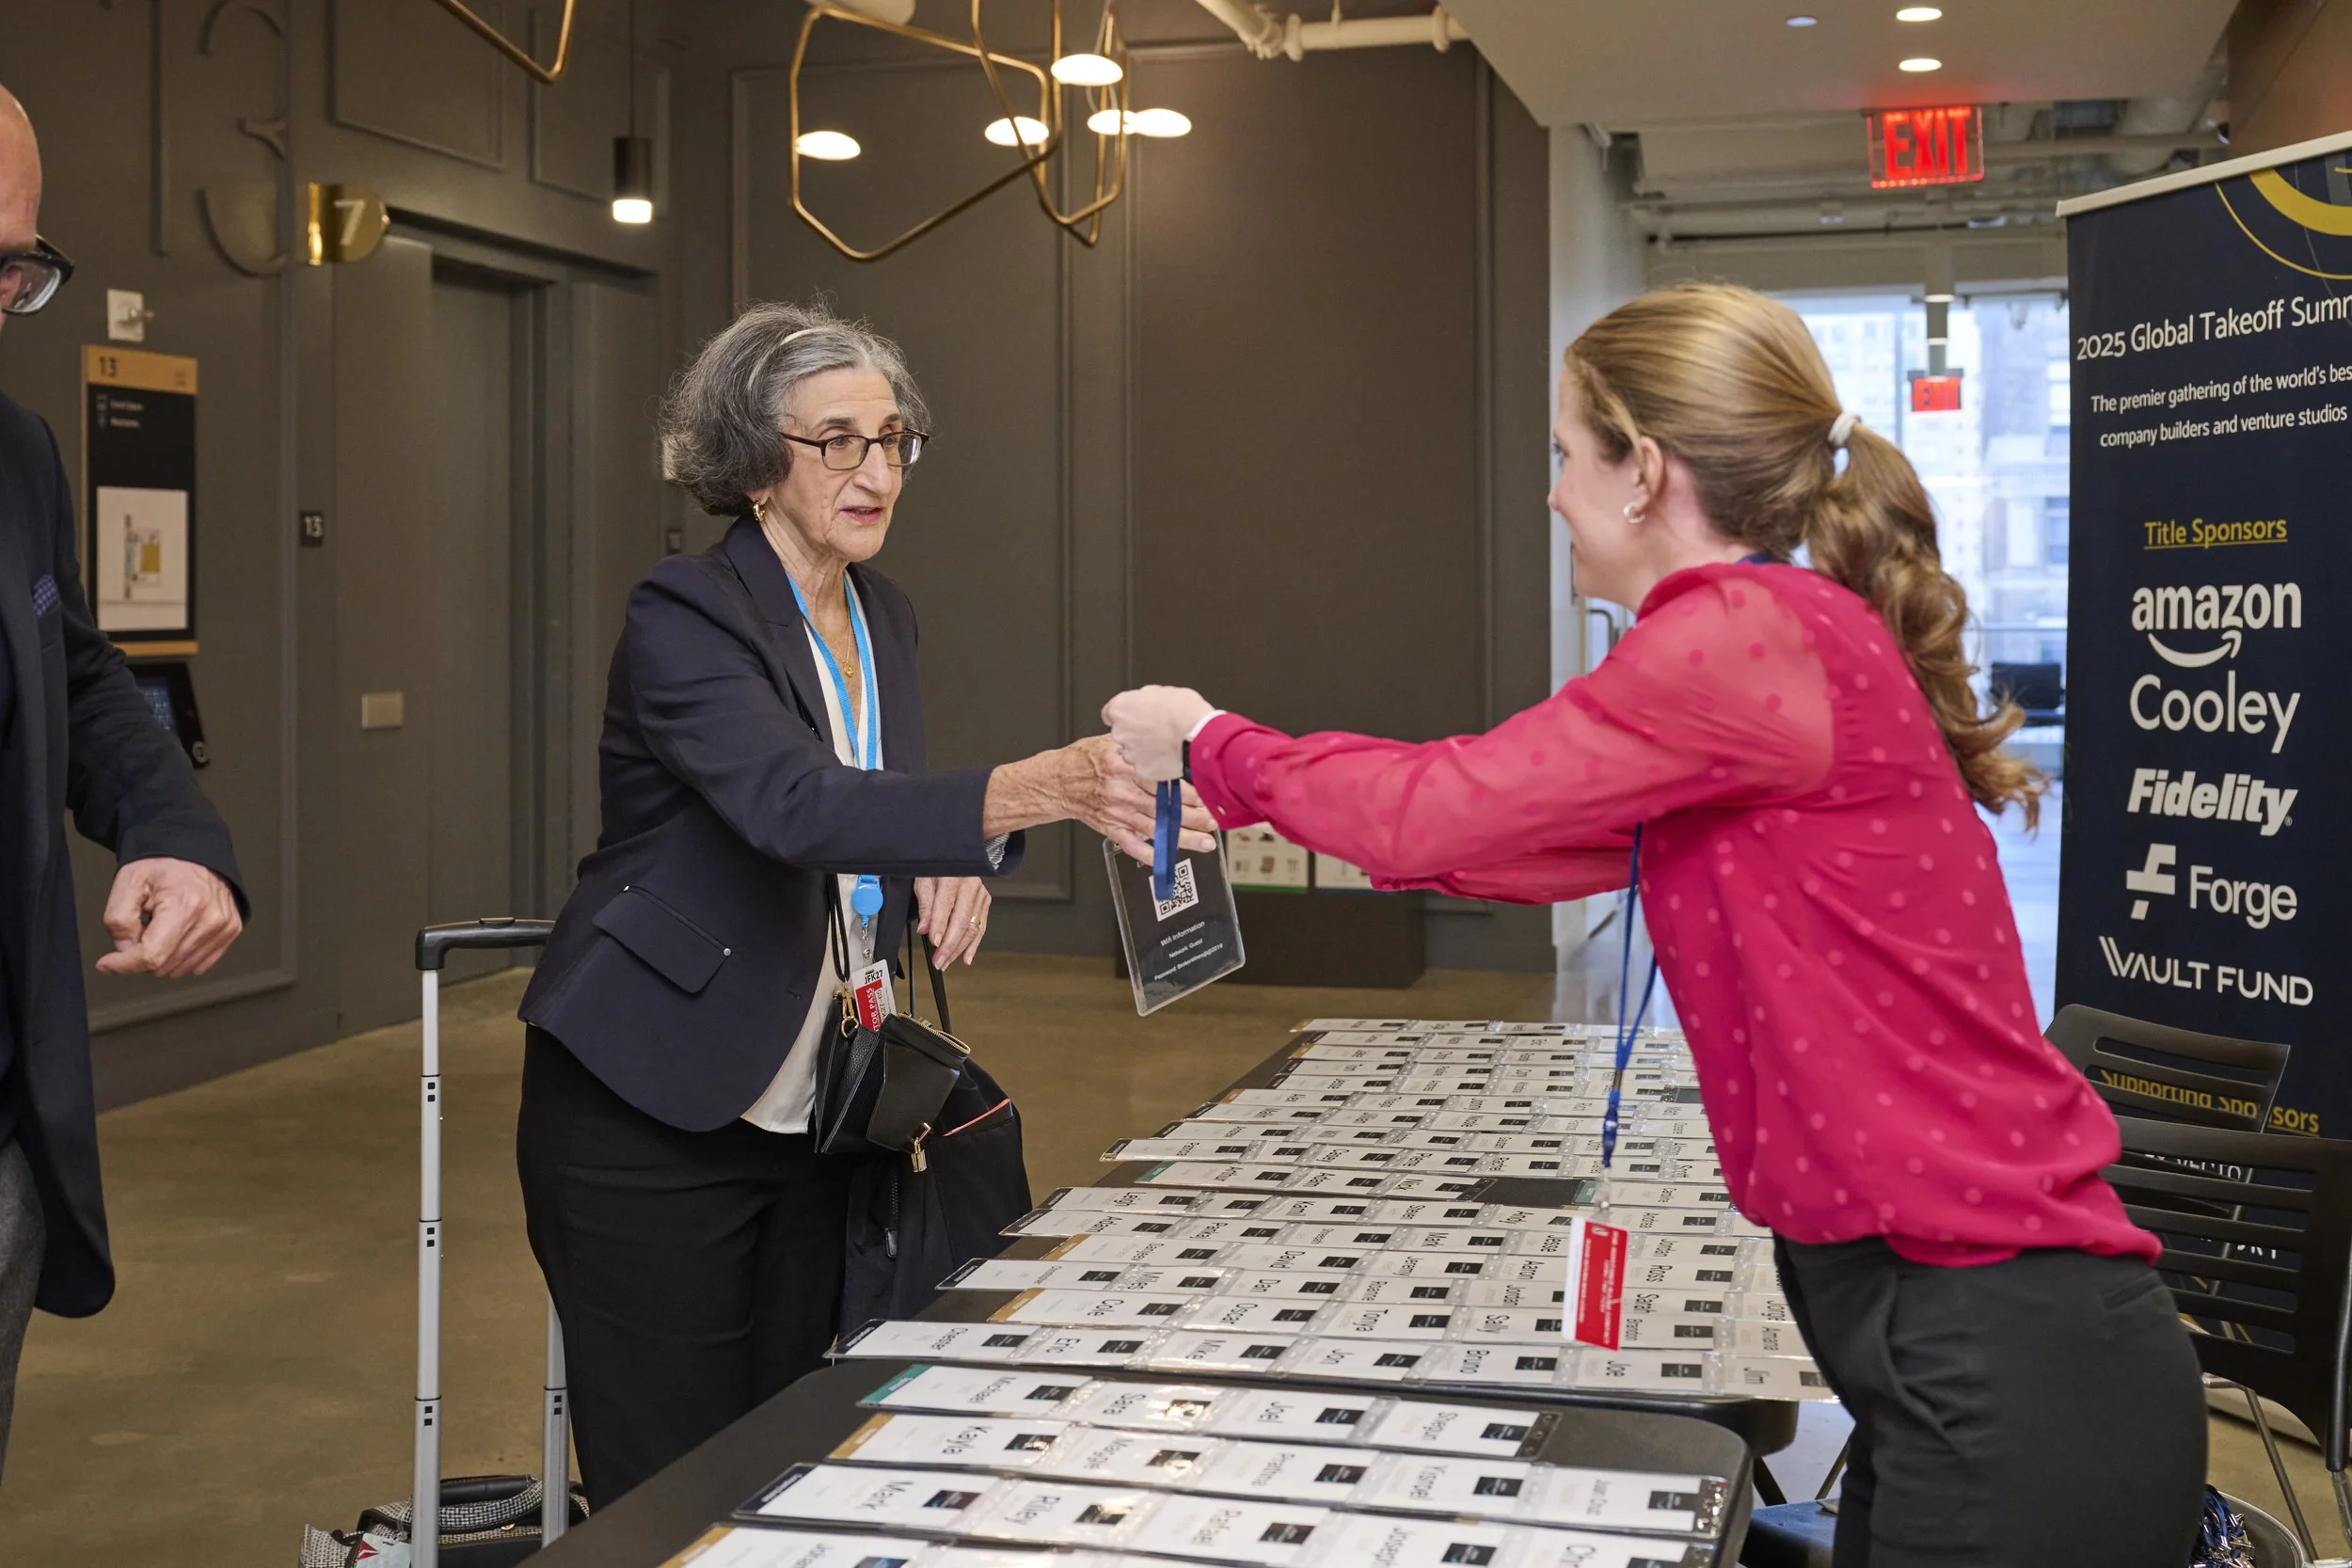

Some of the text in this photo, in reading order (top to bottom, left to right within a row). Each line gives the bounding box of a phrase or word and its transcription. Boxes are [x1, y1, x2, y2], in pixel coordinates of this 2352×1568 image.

[1883, 105, 1971, 179] EXIT
[334, 199, 365, 245] 7
[2077, 331, 2125, 360] 2025
[2131, 314, 2193, 353] Global
[2200, 299, 2284, 341] Takeoff
[100, 356, 119, 378] 13
[2091, 394, 2117, 414] The
[2120, 388, 2166, 414] premier
[2169, 380, 2230, 408] gathering
[2233, 375, 2248, 395] of
[2249, 373, 2272, 393] the
[2276, 365, 2327, 389] world's
[2100, 403, 2348, 450] company builders and venture studios
[2144, 517, 2287, 549] Title Sponsors
[2131, 582, 2302, 631] amazon
[2129, 670, 2301, 754] Cooley
[2126, 768, 2299, 836] Fidelity
[2189, 864, 2297, 929] Forge
[1172, 921, 1205, 942] Information
[865, 969, 883, 985] JFK27
[2098, 935, 2313, 1007] VAULT FUND
[866, 988, 877, 1010] PASS
[1316, 1149, 1349, 1163] Casey
[1215, 1166, 1243, 1181] Arthur
[1303, 1173, 1335, 1187] Adam
[1392, 1179, 1423, 1190] Nick
[1114, 1192, 1146, 1206] Leigh
[1401, 1205, 1425, 1219] Steven
[1499, 1211, 1534, 1224] Andy
[1640, 1212, 1660, 1227] Andrea
[1087, 1216, 1122, 1232] Adam
[1189, 1223, 1228, 1239] Pankaj
[1422, 1232, 1449, 1246] Mark
[1541, 1235, 1566, 1252] Jesse
[1655, 1239, 1678, 1257] Jordan
[1270, 1251, 1305, 1268] David
[1393, 1257, 1422, 1277] Jeremy
[1518, 1260, 1544, 1279] Aaron
[1646, 1265, 1673, 1281] Ross
[1253, 1279, 1280, 1291] Dan
[1503, 1285, 1525, 1307] Jordan
[1634, 1294, 1660, 1313] Sarah
[1088, 1300, 1124, 1316] Cole
[1221, 1304, 1258, 1324] Oscar
[1353, 1309, 1389, 1331] Tonya
[1476, 1315, 1510, 1333] Sally
[1185, 1339, 1227, 1359] Mike
[1321, 1350, 1352, 1364] Jon
[1460, 1351, 1490, 1372] Bruno
[1606, 1361, 1630, 1377] Joe
[1103, 1394, 1146, 1414] Sara
[1258, 1402, 1293, 1423] Joel
[942, 1426, 990, 1454] Kayla
[863, 1481, 914, 1510] Mark
[1005, 1496, 1061, 1525] Riley
